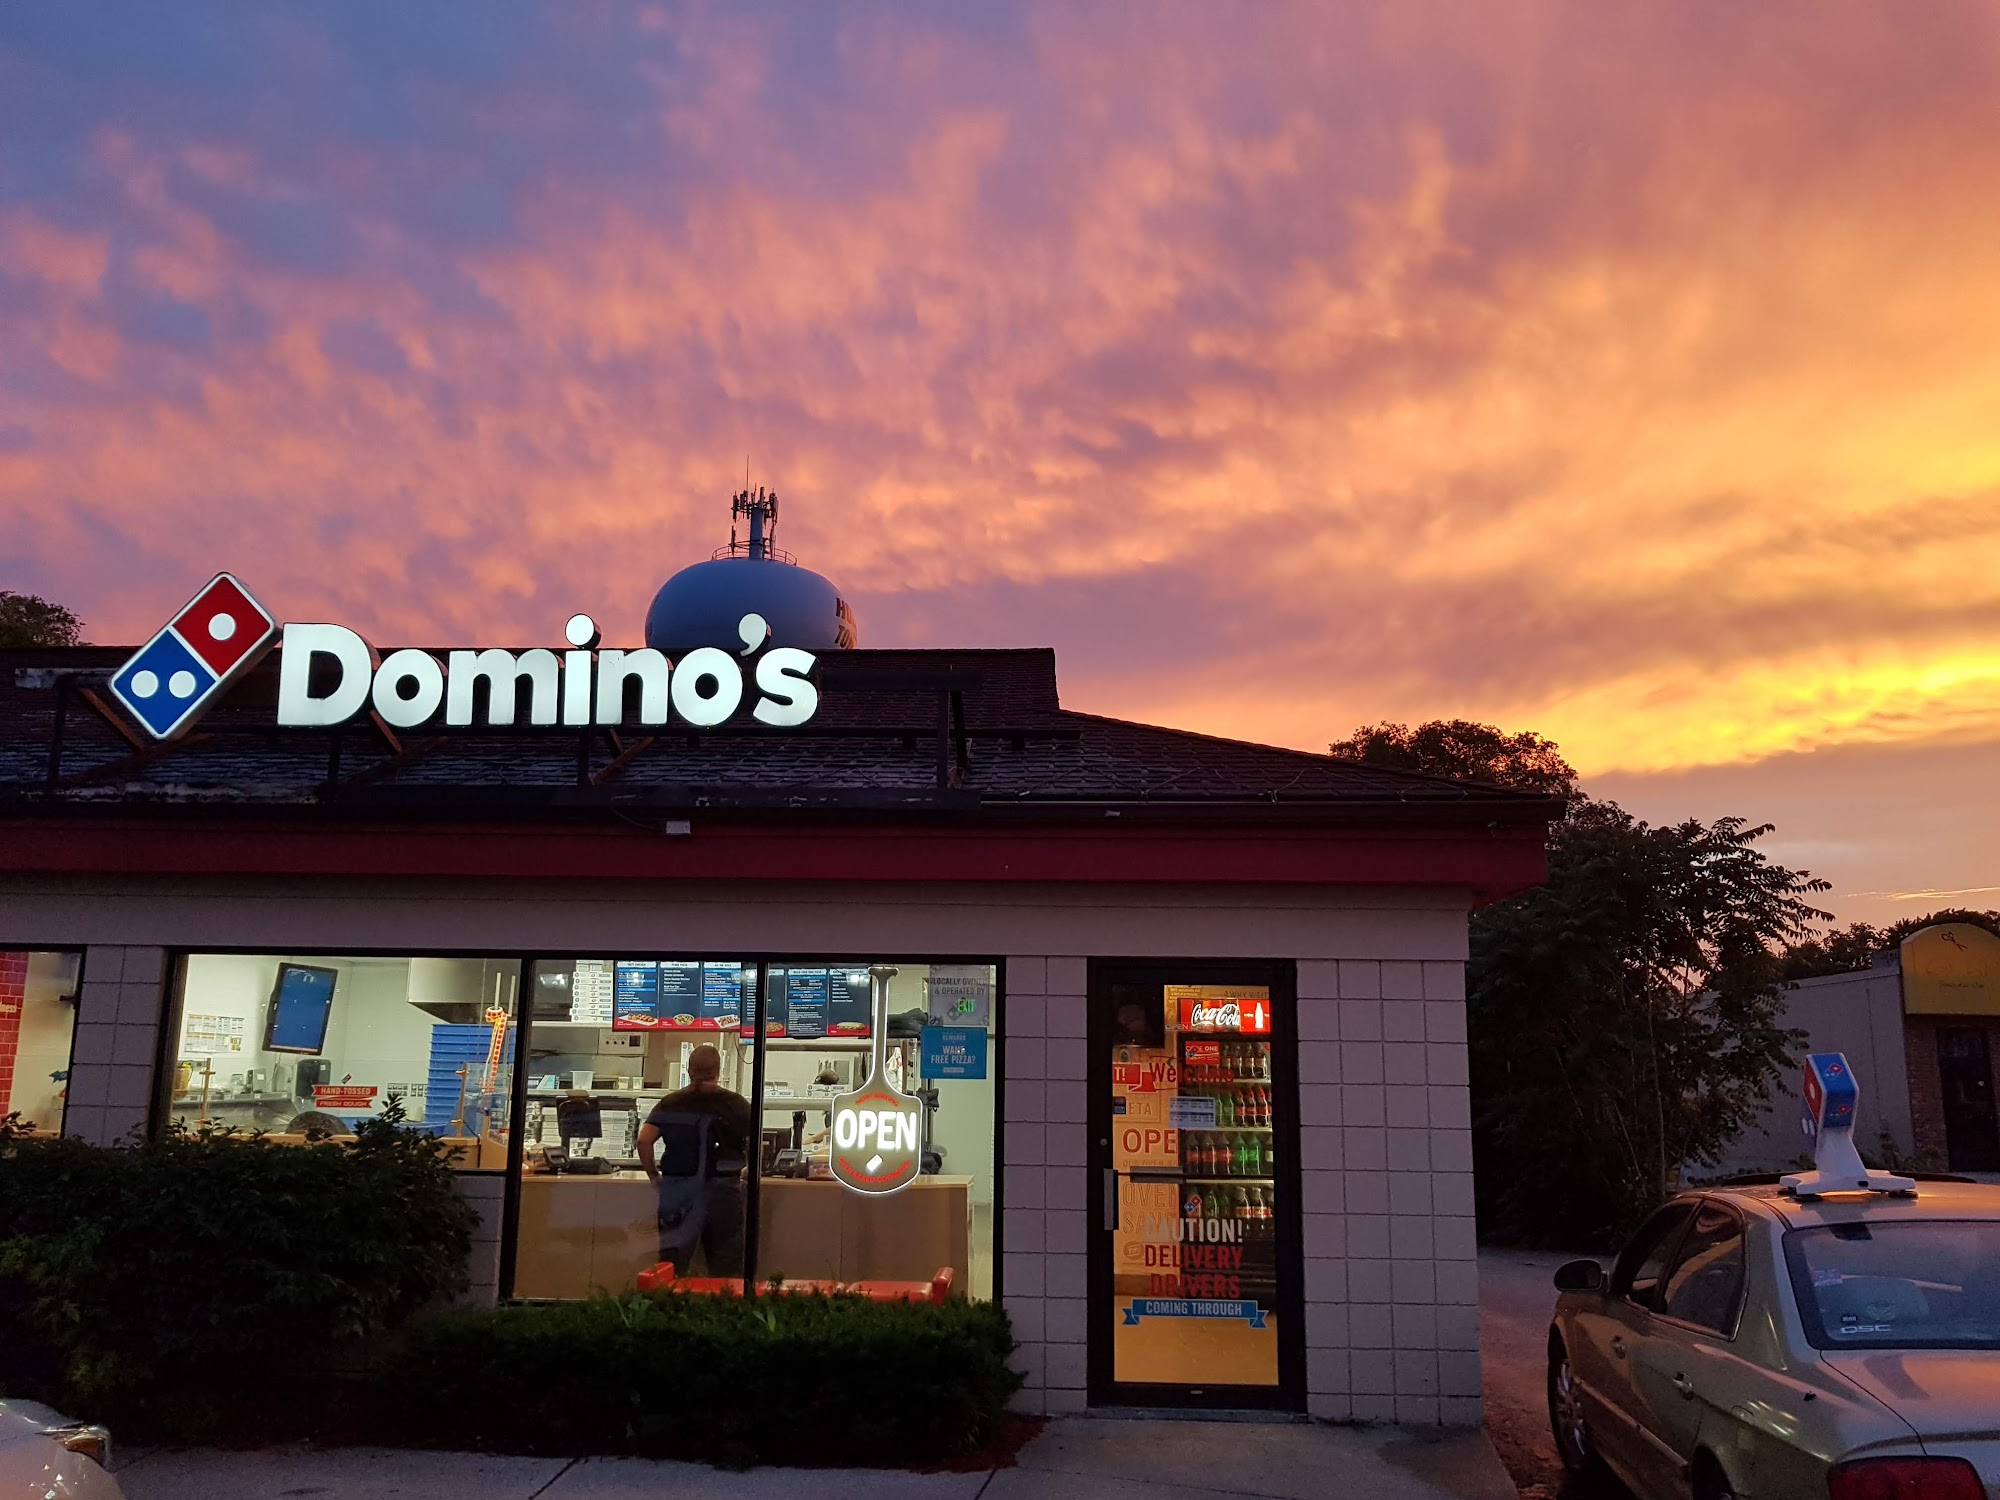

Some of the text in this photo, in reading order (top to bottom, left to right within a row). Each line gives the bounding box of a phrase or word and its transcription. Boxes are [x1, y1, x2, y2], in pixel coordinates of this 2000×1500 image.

[277, 613, 819, 728] Domino's
[931, 977, 961, 986] LOCALLY
[934, 987, 986, 996] & OPERATED BY
[957, 999, 975, 1013] EXIT
[1191, 1003, 1240, 1027] Coca-Cola
[930, 1055, 976, 1064] FREE PIZZA?
[1150, 1062, 1235, 1083] Welcome
[320, 1086, 371, 1095] HAND-TOSSED
[835, 1109, 917, 1151] OPEN
[1143, 1218, 1243, 1243] CAUTION!
[1144, 1244, 1243, 1269] DELIVERY
[1150, 1273, 1241, 1299] DRIVERS
[1145, 1301, 1242, 1316] COMING THROUGH
